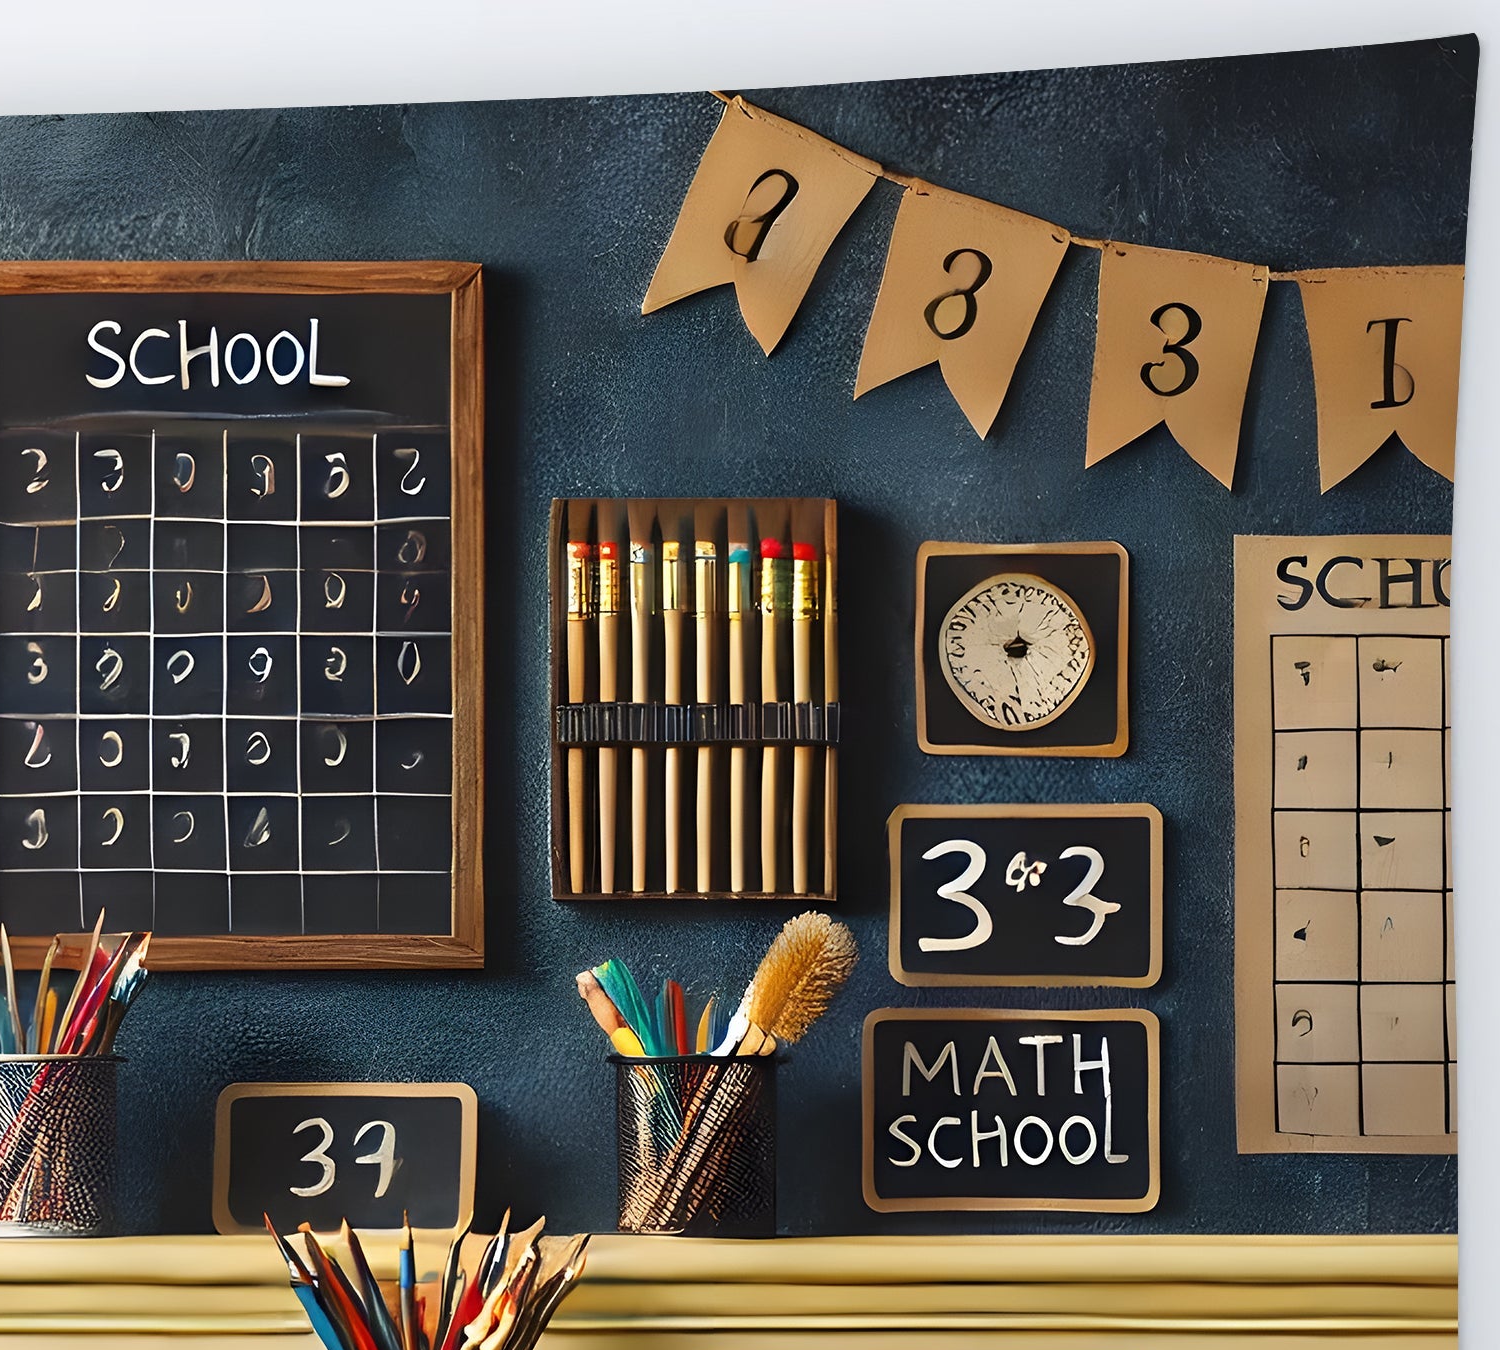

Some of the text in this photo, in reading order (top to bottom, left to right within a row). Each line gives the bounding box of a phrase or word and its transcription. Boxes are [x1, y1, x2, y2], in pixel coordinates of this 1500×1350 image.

[85, 317, 351, 390] SCHOOL
[920, 838, 993, 952] 3
[901, 1033, 1112, 1098] MATH
[888, 1098, 1130, 1169] SCHOOL
